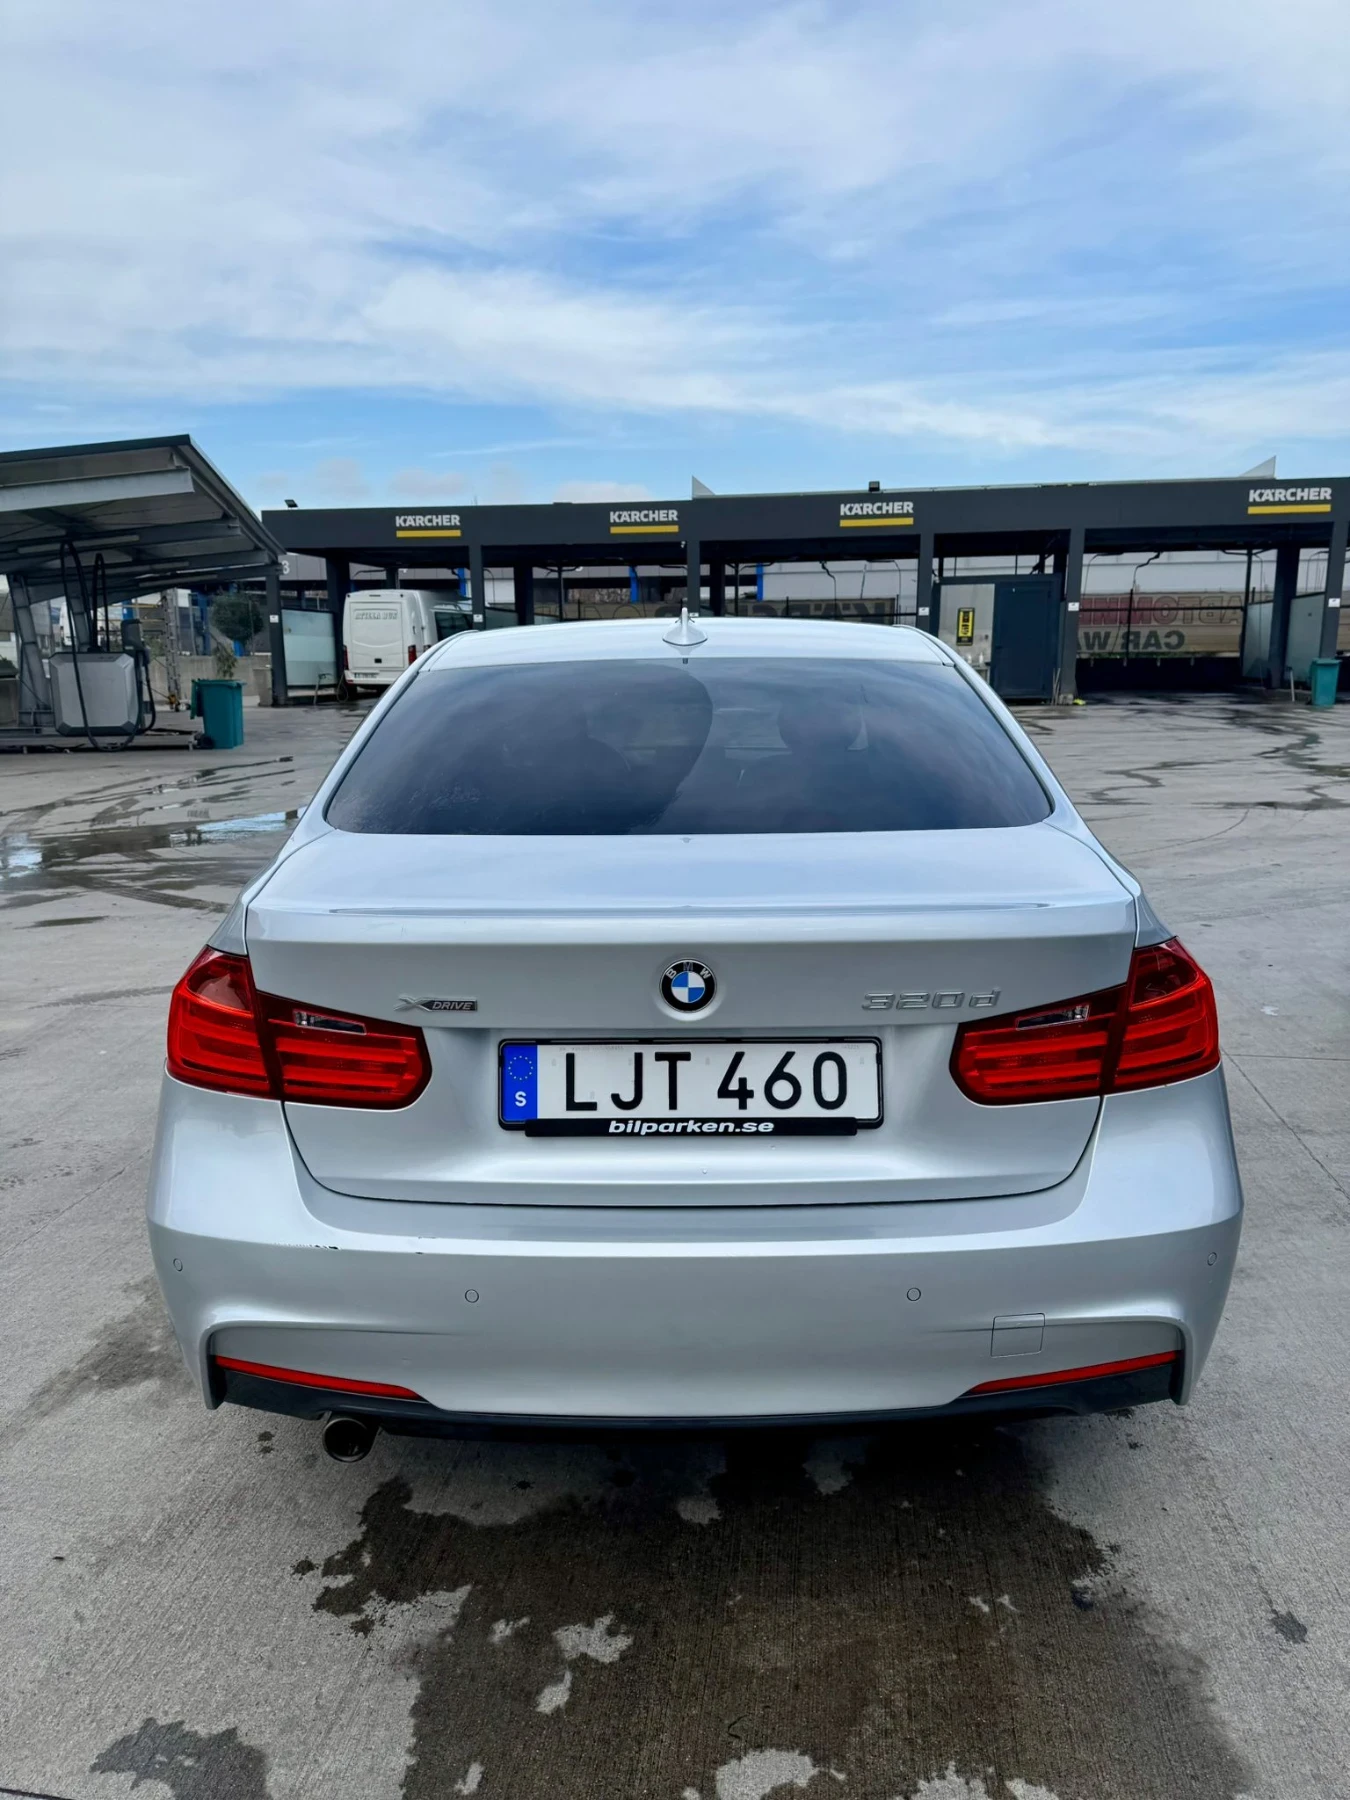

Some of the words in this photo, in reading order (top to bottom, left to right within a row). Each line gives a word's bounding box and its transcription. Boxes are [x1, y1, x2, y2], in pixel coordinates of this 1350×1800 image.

[1248, 487, 1332, 502] KÄRCHER
[609, 509, 679, 523] KÄRCHER
[840, 501, 914, 516] KÄRCHER
[395, 514, 461, 527] KÄRCHER
[665, 961, 711, 980] BMW
[861, 986, 1002, 1010] 320d
[565, 1051, 692, 1111] LJT
[717, 1051, 847, 1110] 460
[514, 1091, 527, 1107] S
[608, 1119, 775, 1135] bilparken.se
